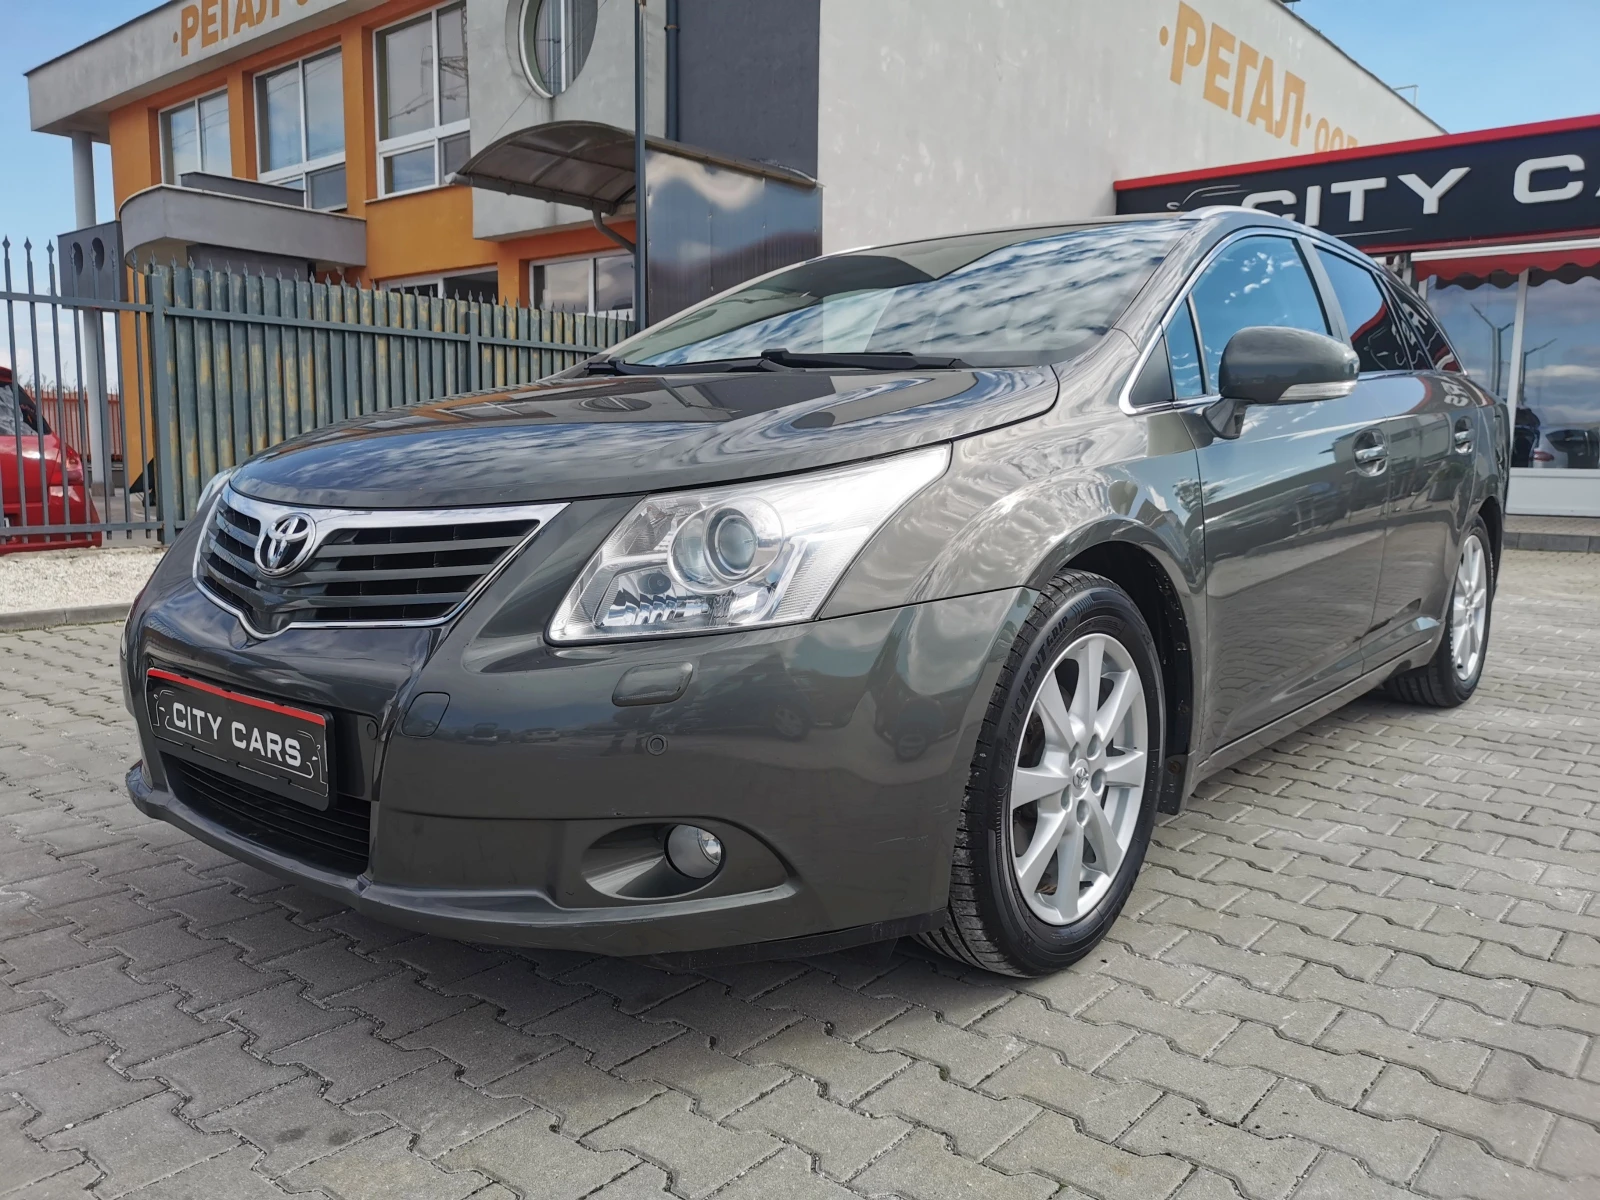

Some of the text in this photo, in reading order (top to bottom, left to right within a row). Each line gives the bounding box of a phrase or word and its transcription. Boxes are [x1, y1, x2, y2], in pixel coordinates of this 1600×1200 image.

[1513, 154, 1600, 204] C
[172, 702, 301, 767] CITY CARS
[1000, 642, 1047, 769] EFFICIENT
